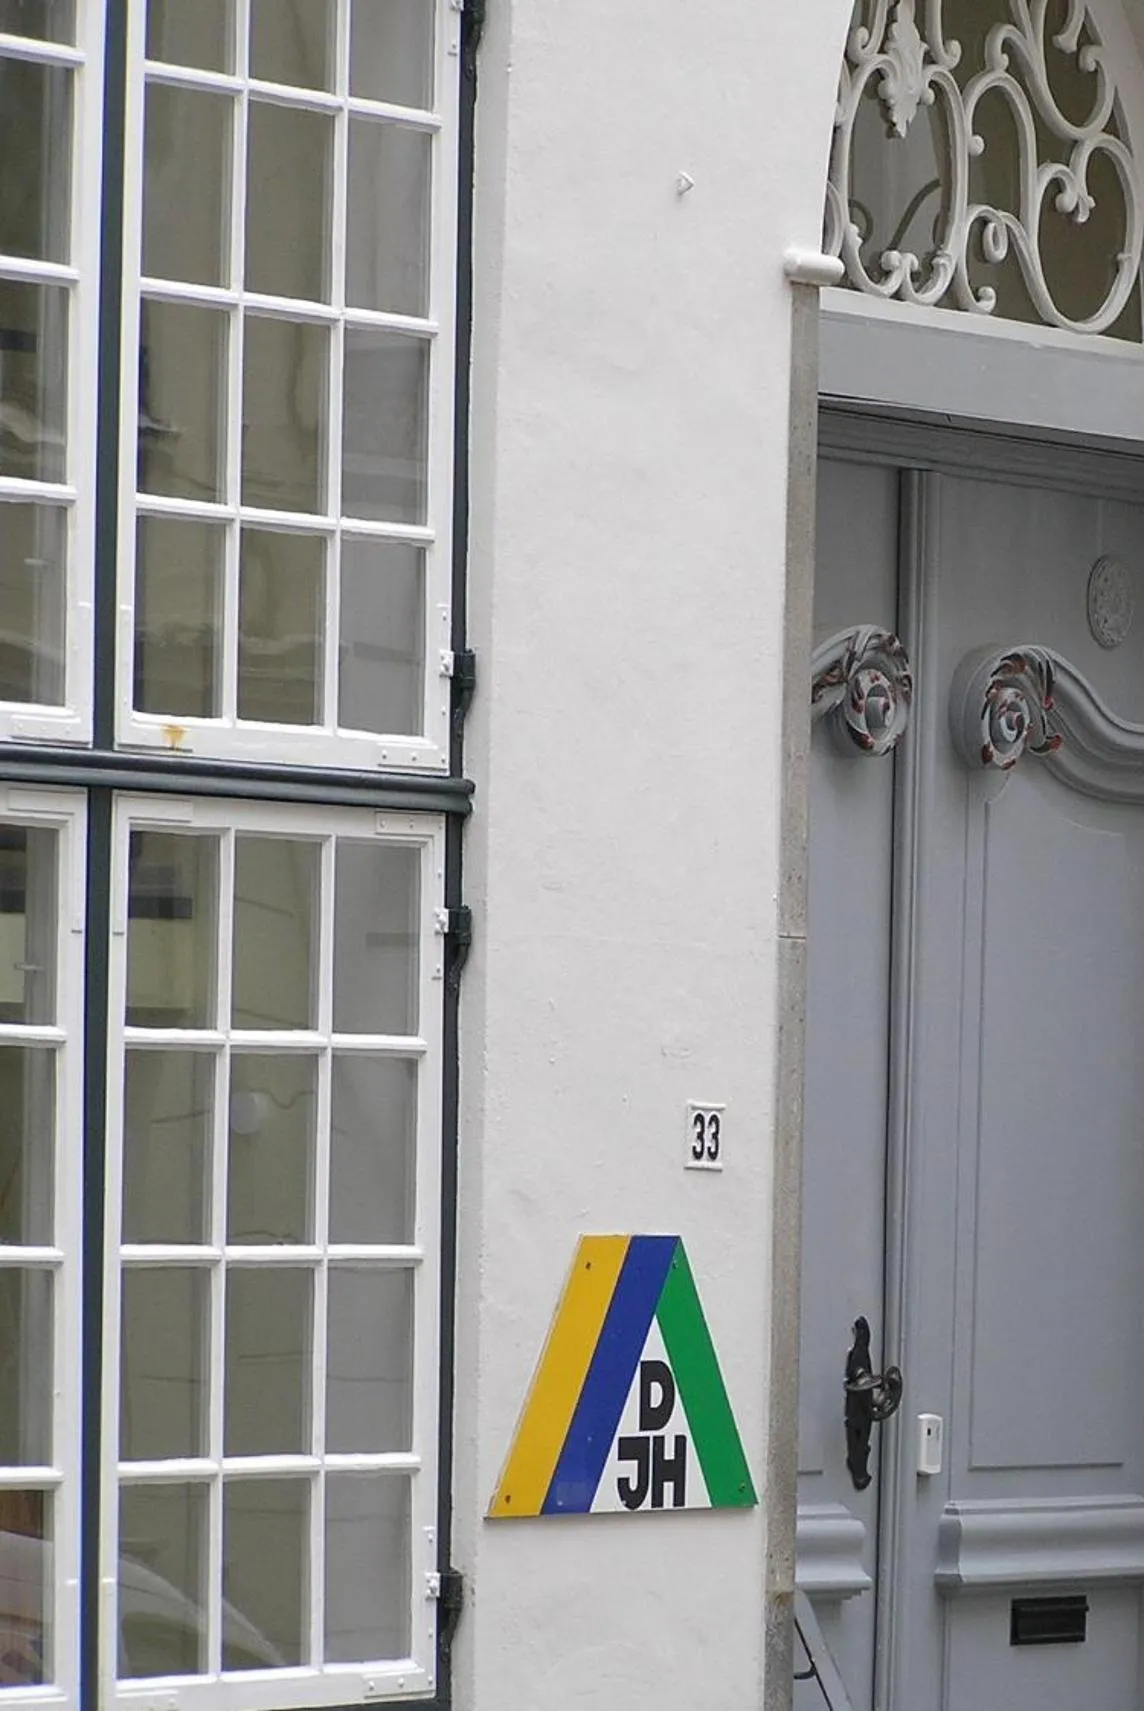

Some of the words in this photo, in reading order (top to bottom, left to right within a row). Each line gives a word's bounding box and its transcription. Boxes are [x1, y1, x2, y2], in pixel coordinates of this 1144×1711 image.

[692, 1111, 721, 1161] 33
[639, 1360, 675, 1432] D
[617, 1434, 687, 1510] JH
